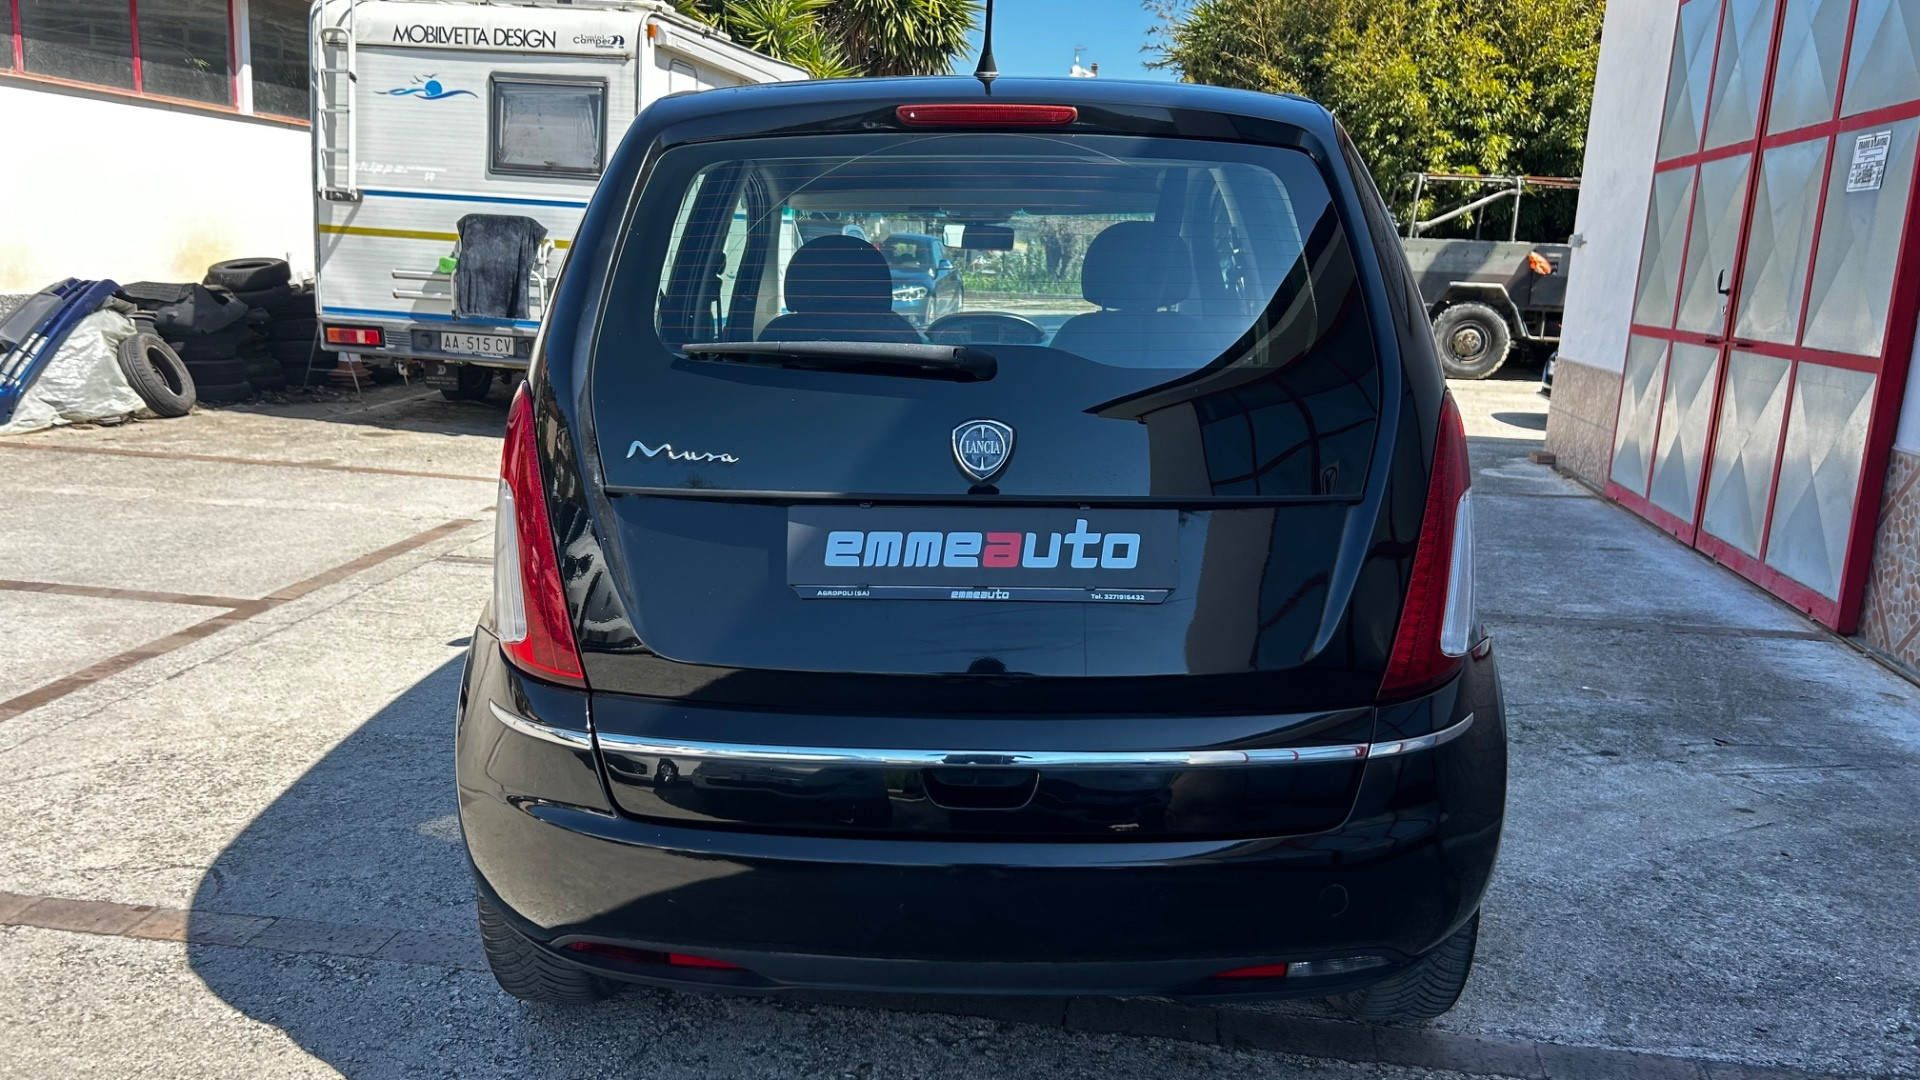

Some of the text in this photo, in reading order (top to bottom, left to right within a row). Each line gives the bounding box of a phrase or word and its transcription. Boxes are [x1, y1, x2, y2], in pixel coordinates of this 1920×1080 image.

[393, 24, 556, 49] MOBILVETTA DESIGN
[572, 36, 611, 48] Camper
[444, 334, 512, 353] AA 515 CV
[626, 440, 740, 463] Musa
[965, 440, 1001, 454] LANCIA
[824, 518, 1141, 569] emmeauto
[951, 588, 1010, 600] emmeauto
